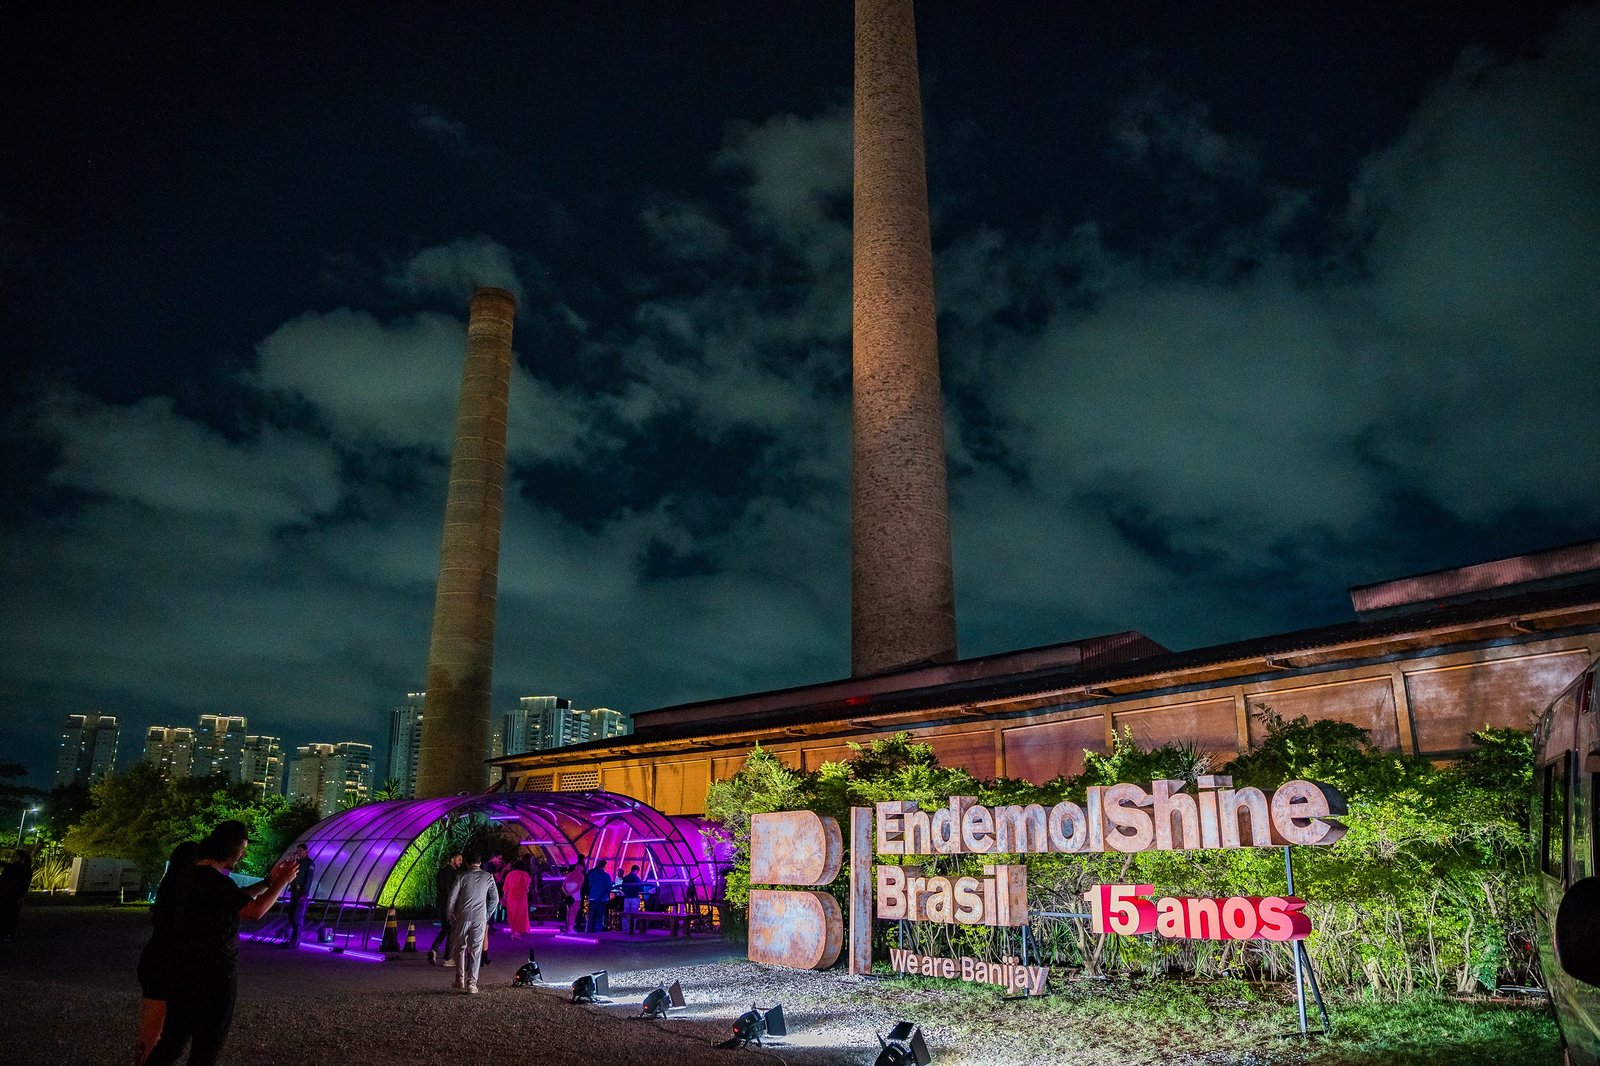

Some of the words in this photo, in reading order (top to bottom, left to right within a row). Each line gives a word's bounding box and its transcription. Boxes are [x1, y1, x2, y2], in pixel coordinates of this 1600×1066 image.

[877, 865, 1012, 927] Brasil
[1083, 884, 1141, 936] 15
[1157, 896, 1295, 941] anos
[889, 948, 918, 974] We
[921, 956, 956, 979] are
[962, 956, 1045, 996] Banijay
